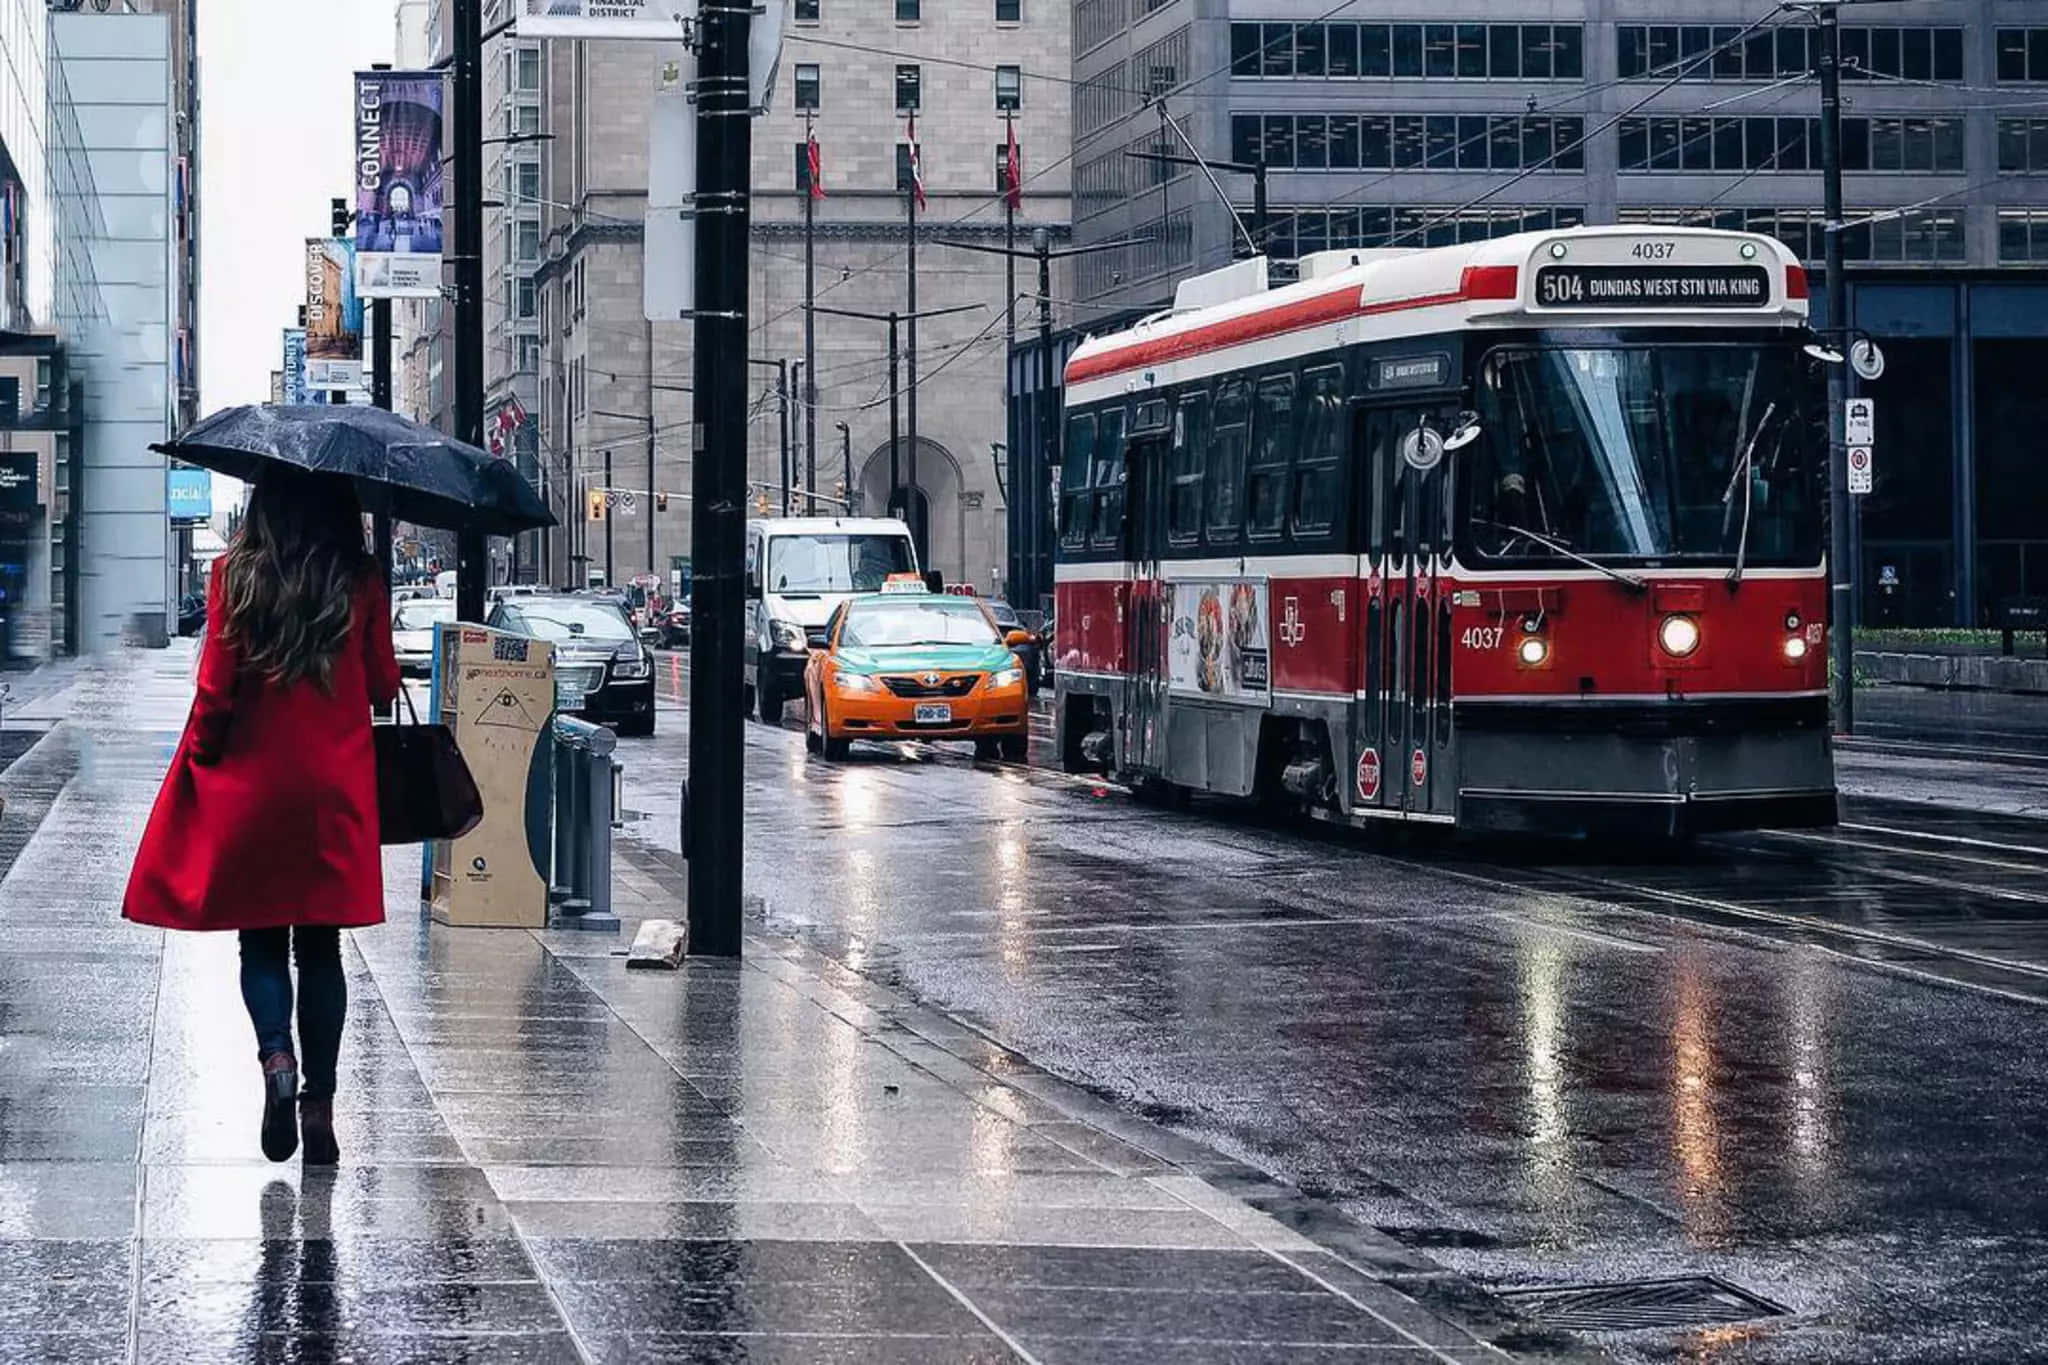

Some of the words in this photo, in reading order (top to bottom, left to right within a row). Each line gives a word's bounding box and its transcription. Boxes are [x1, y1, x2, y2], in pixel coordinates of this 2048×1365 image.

[589, 8, 636, 18] DISTRICT
[360, 81, 380, 190] CONNECT
[1631, 243, 1675, 259] 4037
[309, 243, 324, 321] DISCOVER
[1543, 275, 1583, 301] 504
[1590, 279, 1641, 296] DUNDAS
[1643, 279, 1678, 296] WEST
[1680, 279, 1706, 295] STN
[1706, 279, 1728, 295] VIA
[1730, 279, 1760, 295] KING
[1461, 627, 1504, 649] 4037
[1359, 763, 1379, 783] STOP
